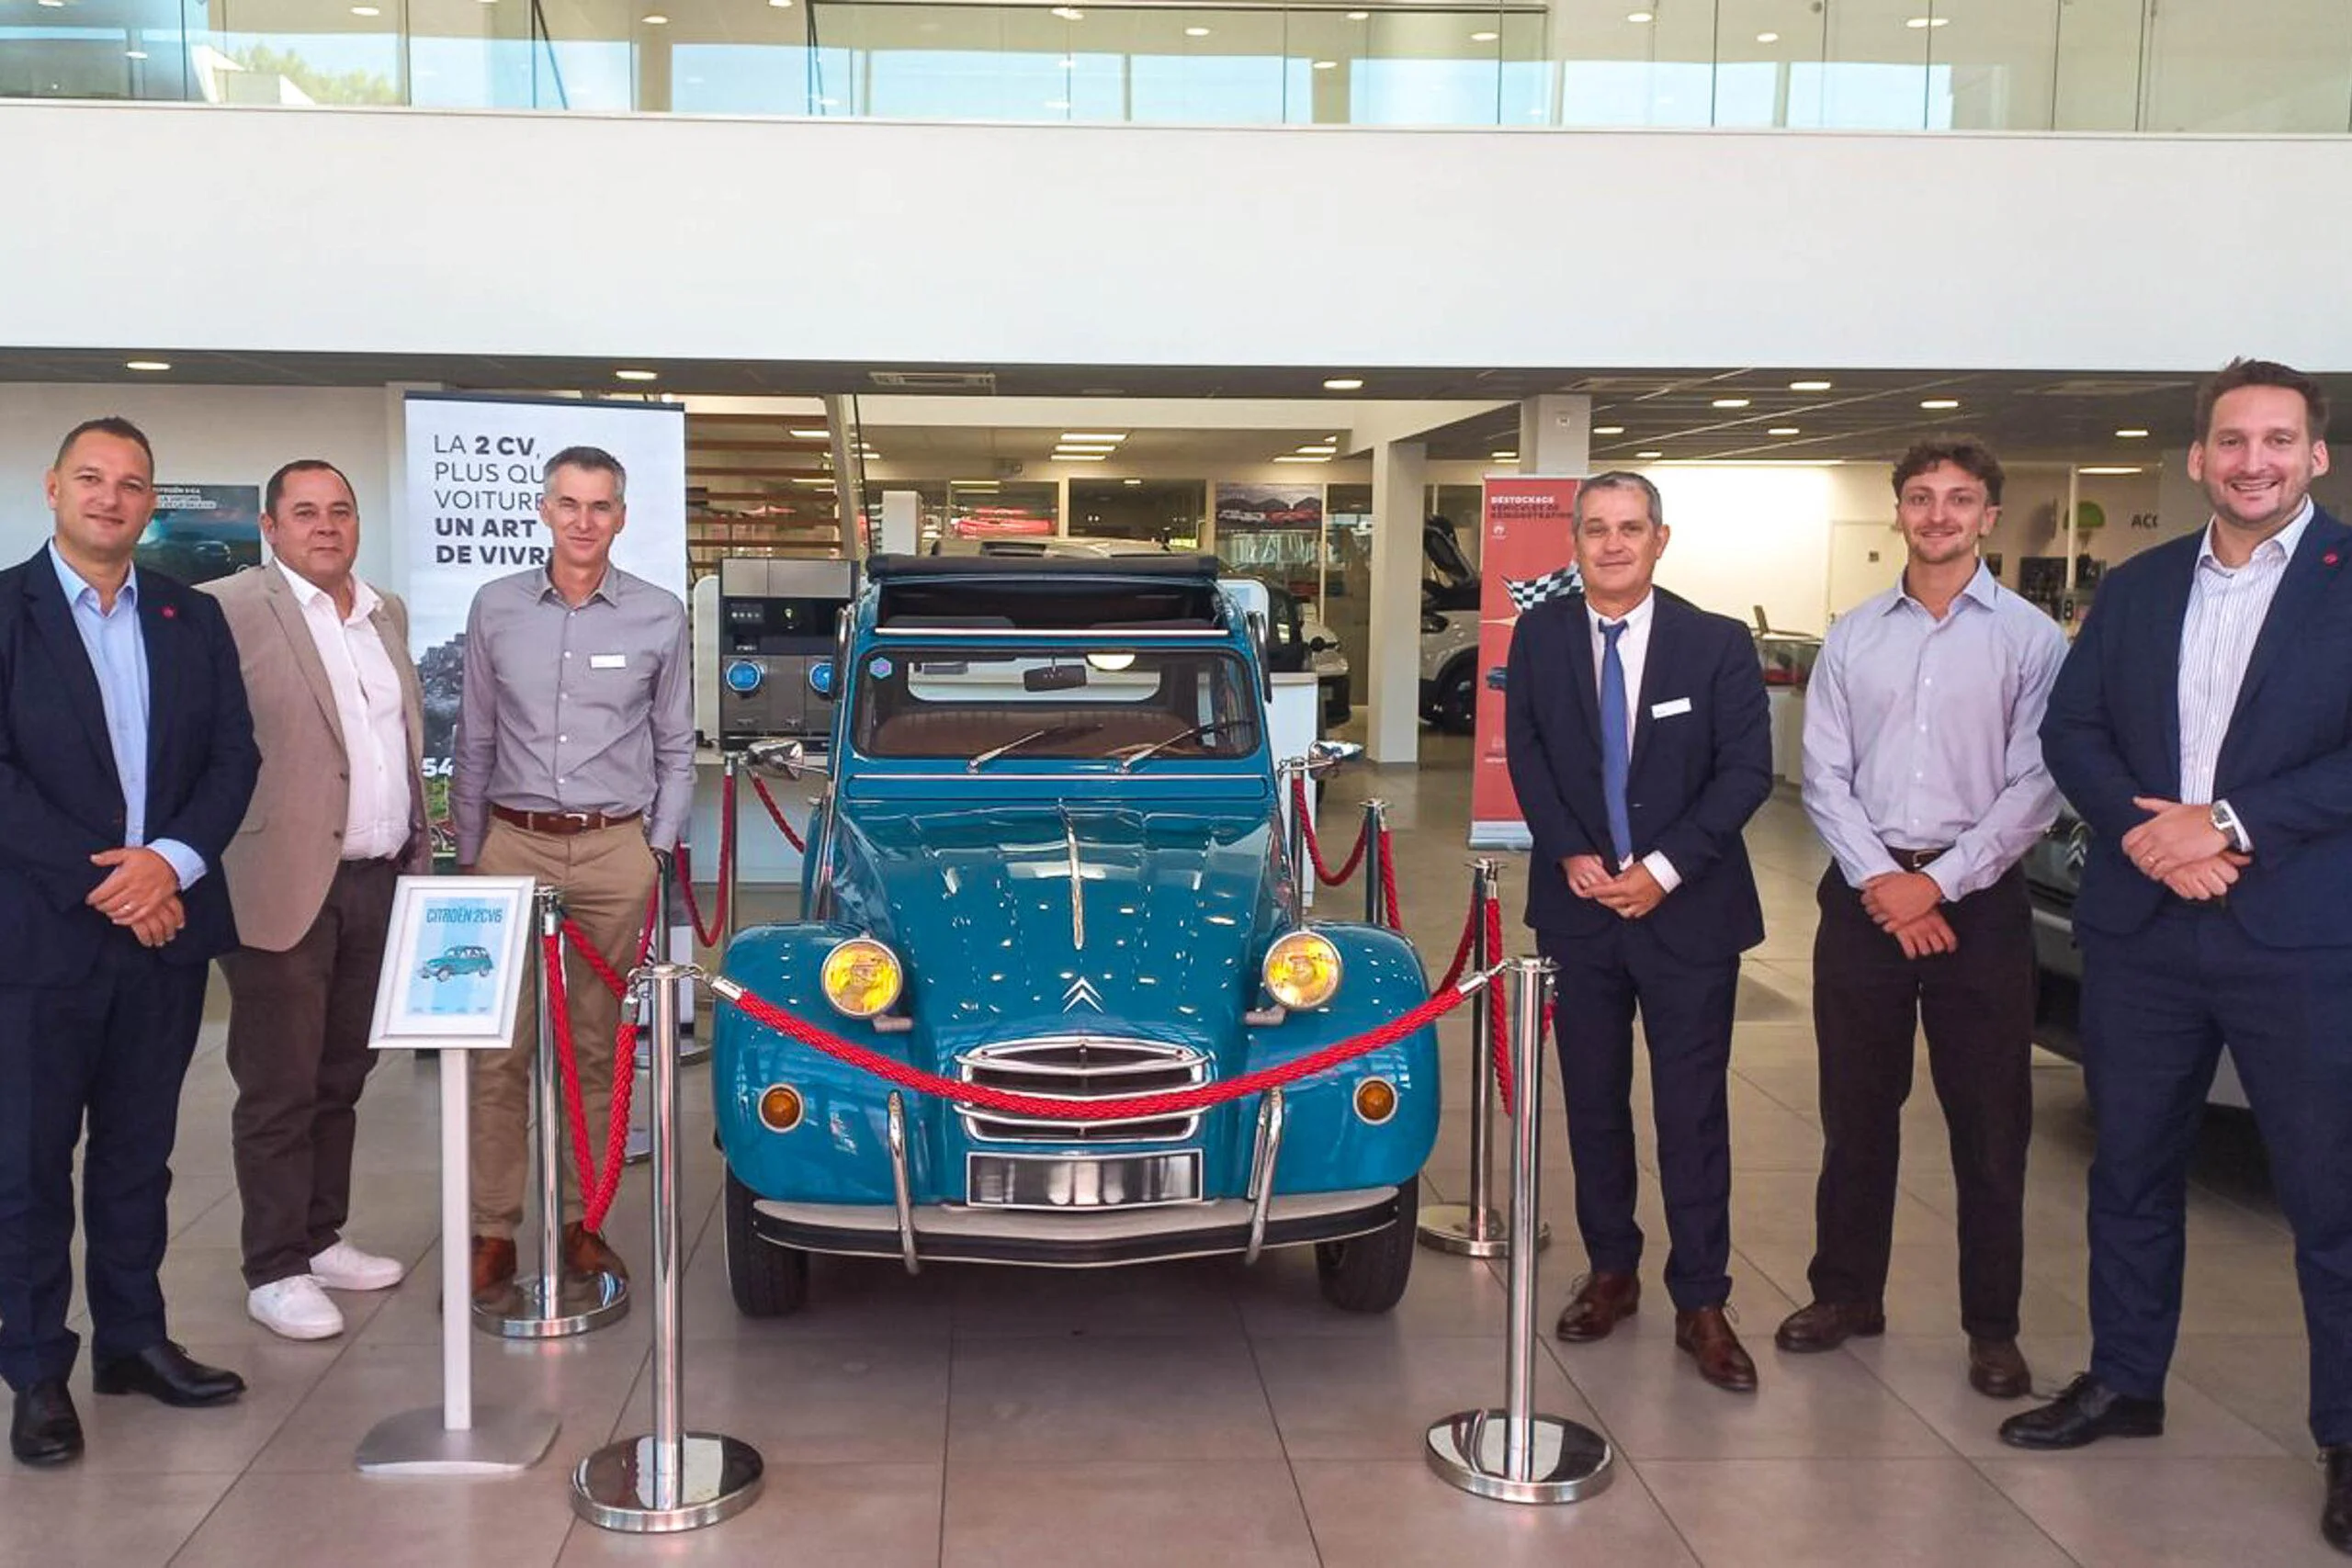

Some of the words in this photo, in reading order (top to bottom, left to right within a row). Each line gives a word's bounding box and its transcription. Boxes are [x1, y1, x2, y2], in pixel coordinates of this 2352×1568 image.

[434, 434, 467, 455] LA
[474, 435, 491, 455] 2
[496, 435, 540, 460] CV,
[435, 461, 500, 483] PLUS
[435, 517, 474, 536] UN
[481, 518, 537, 538] ART
[435, 545, 473, 564] DE
